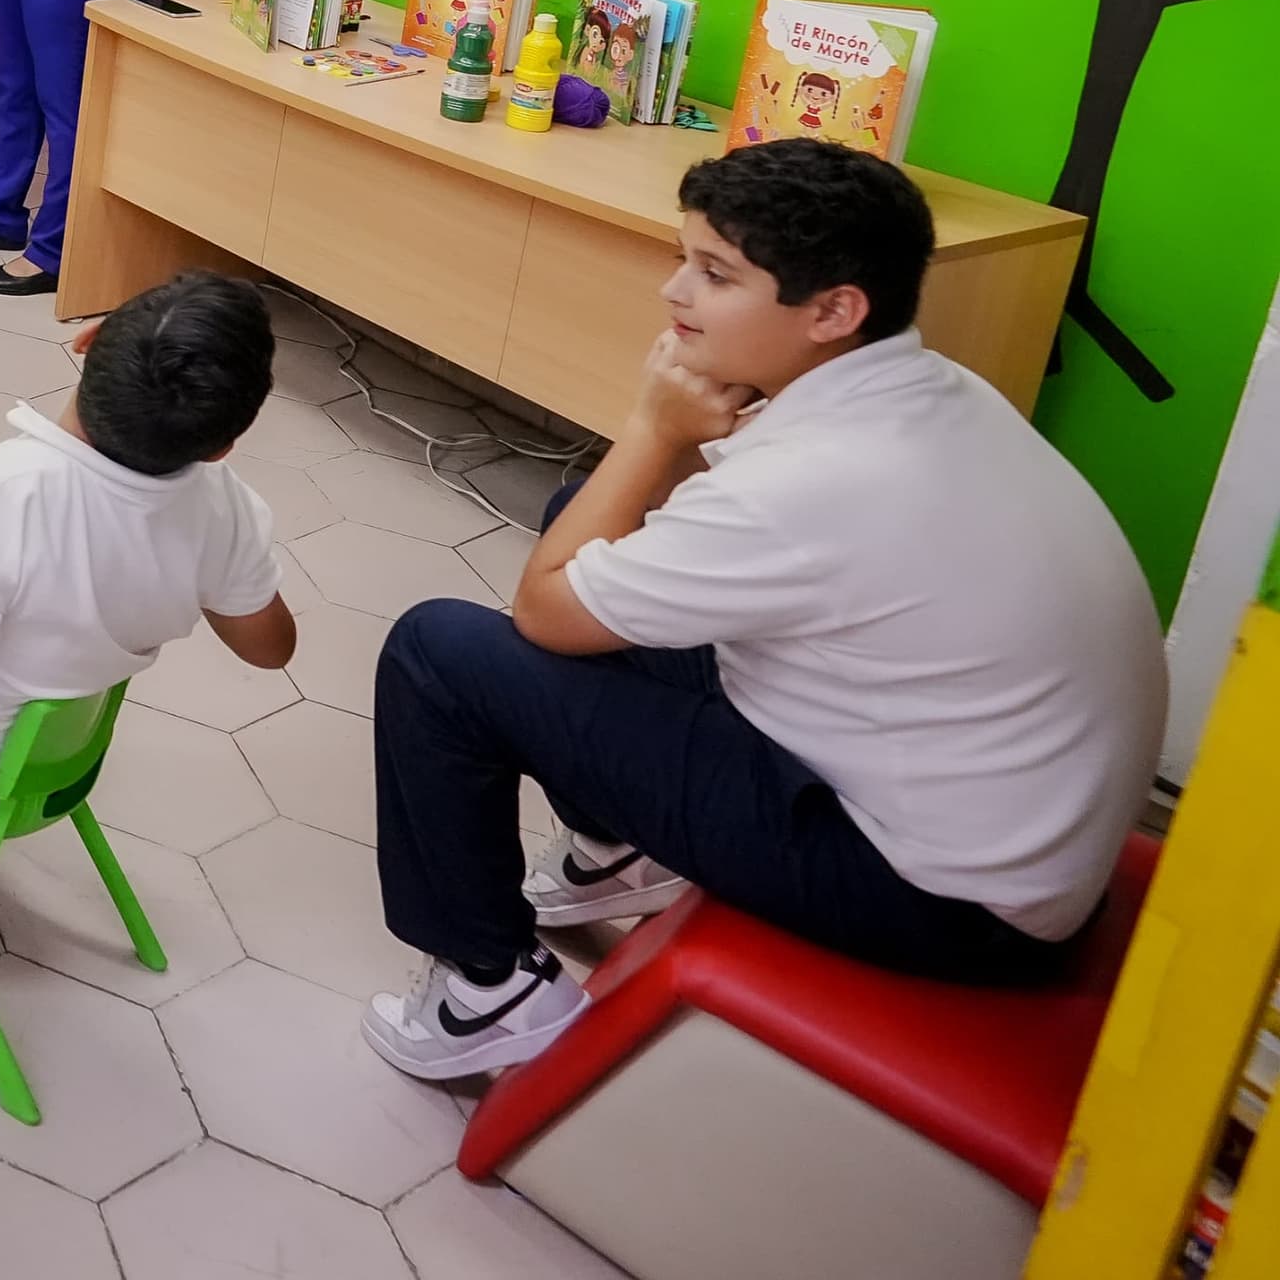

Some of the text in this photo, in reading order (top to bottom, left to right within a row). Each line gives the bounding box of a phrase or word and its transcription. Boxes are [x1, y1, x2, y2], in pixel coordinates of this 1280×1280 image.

[791, 37, 871, 67] de Mayte
[793, 22, 869, 52] El Rincón
